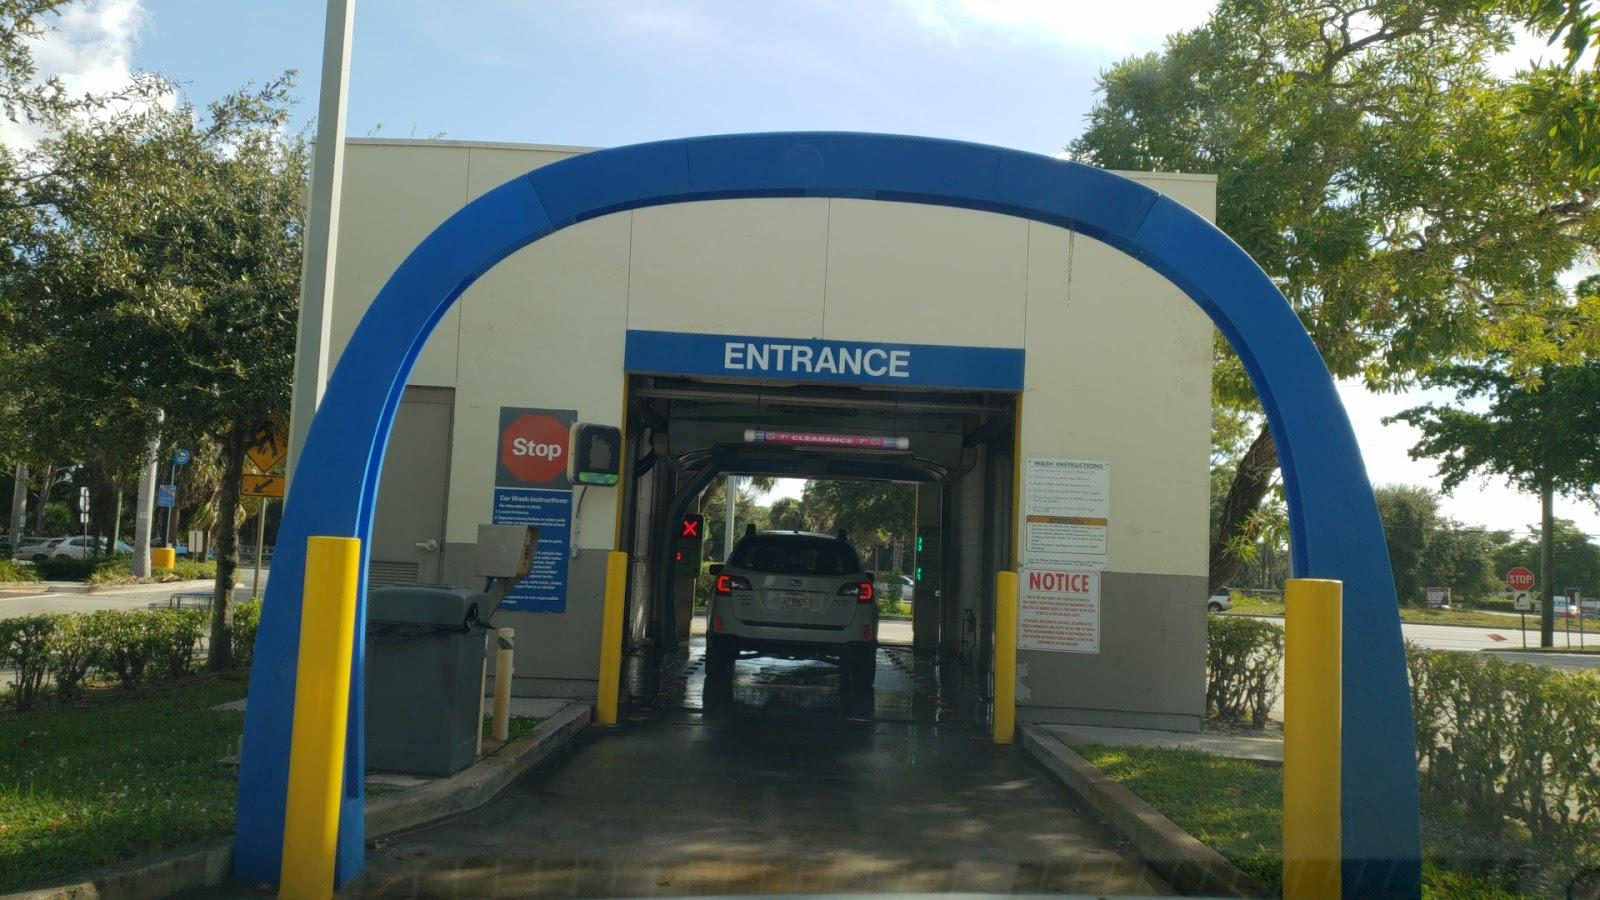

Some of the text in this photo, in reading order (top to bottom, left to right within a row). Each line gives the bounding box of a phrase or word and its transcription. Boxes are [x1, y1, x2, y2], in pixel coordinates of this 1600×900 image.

[724, 342, 910, 378] ENTRANCE
[791, 435, 852, 444] CLEARANCE
[512, 437, 562, 461] Stop
[1056, 461, 1104, 470] INSTRUCTIONS
[1030, 572, 1089, 592] NOTICE
[1509, 574, 1533, 584] STOP
